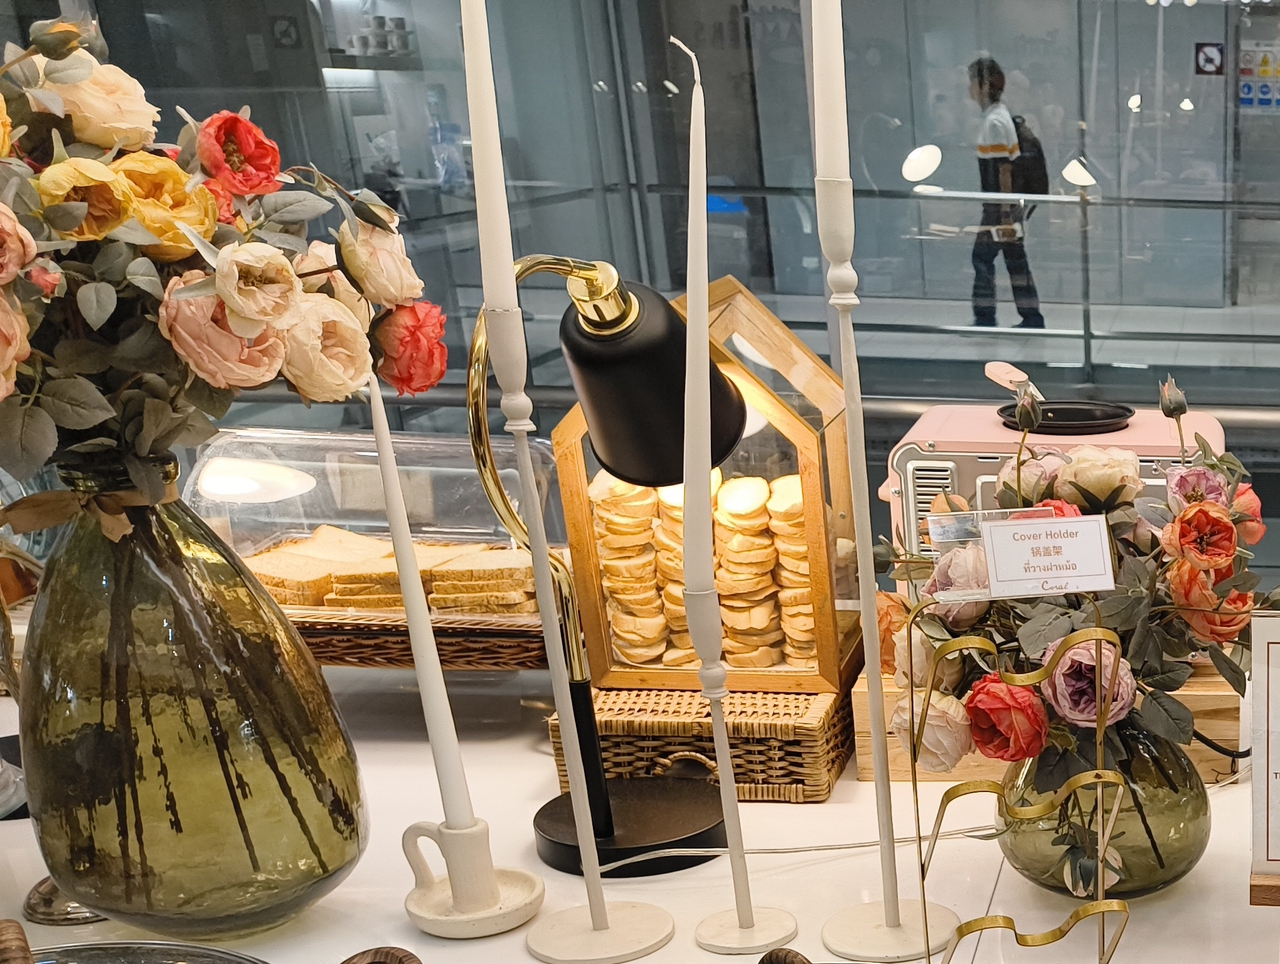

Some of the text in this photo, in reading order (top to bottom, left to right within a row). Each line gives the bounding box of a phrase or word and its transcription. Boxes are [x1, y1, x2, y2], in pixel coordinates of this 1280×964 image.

[1012, 530, 1080, 541] Cover Holder
[1031, 546, 1063, 557] 锅盖架
[1023, 560, 1078, 573] ที่วางฝาหม้อ
[1041, 580, 1069, 591] Coral
